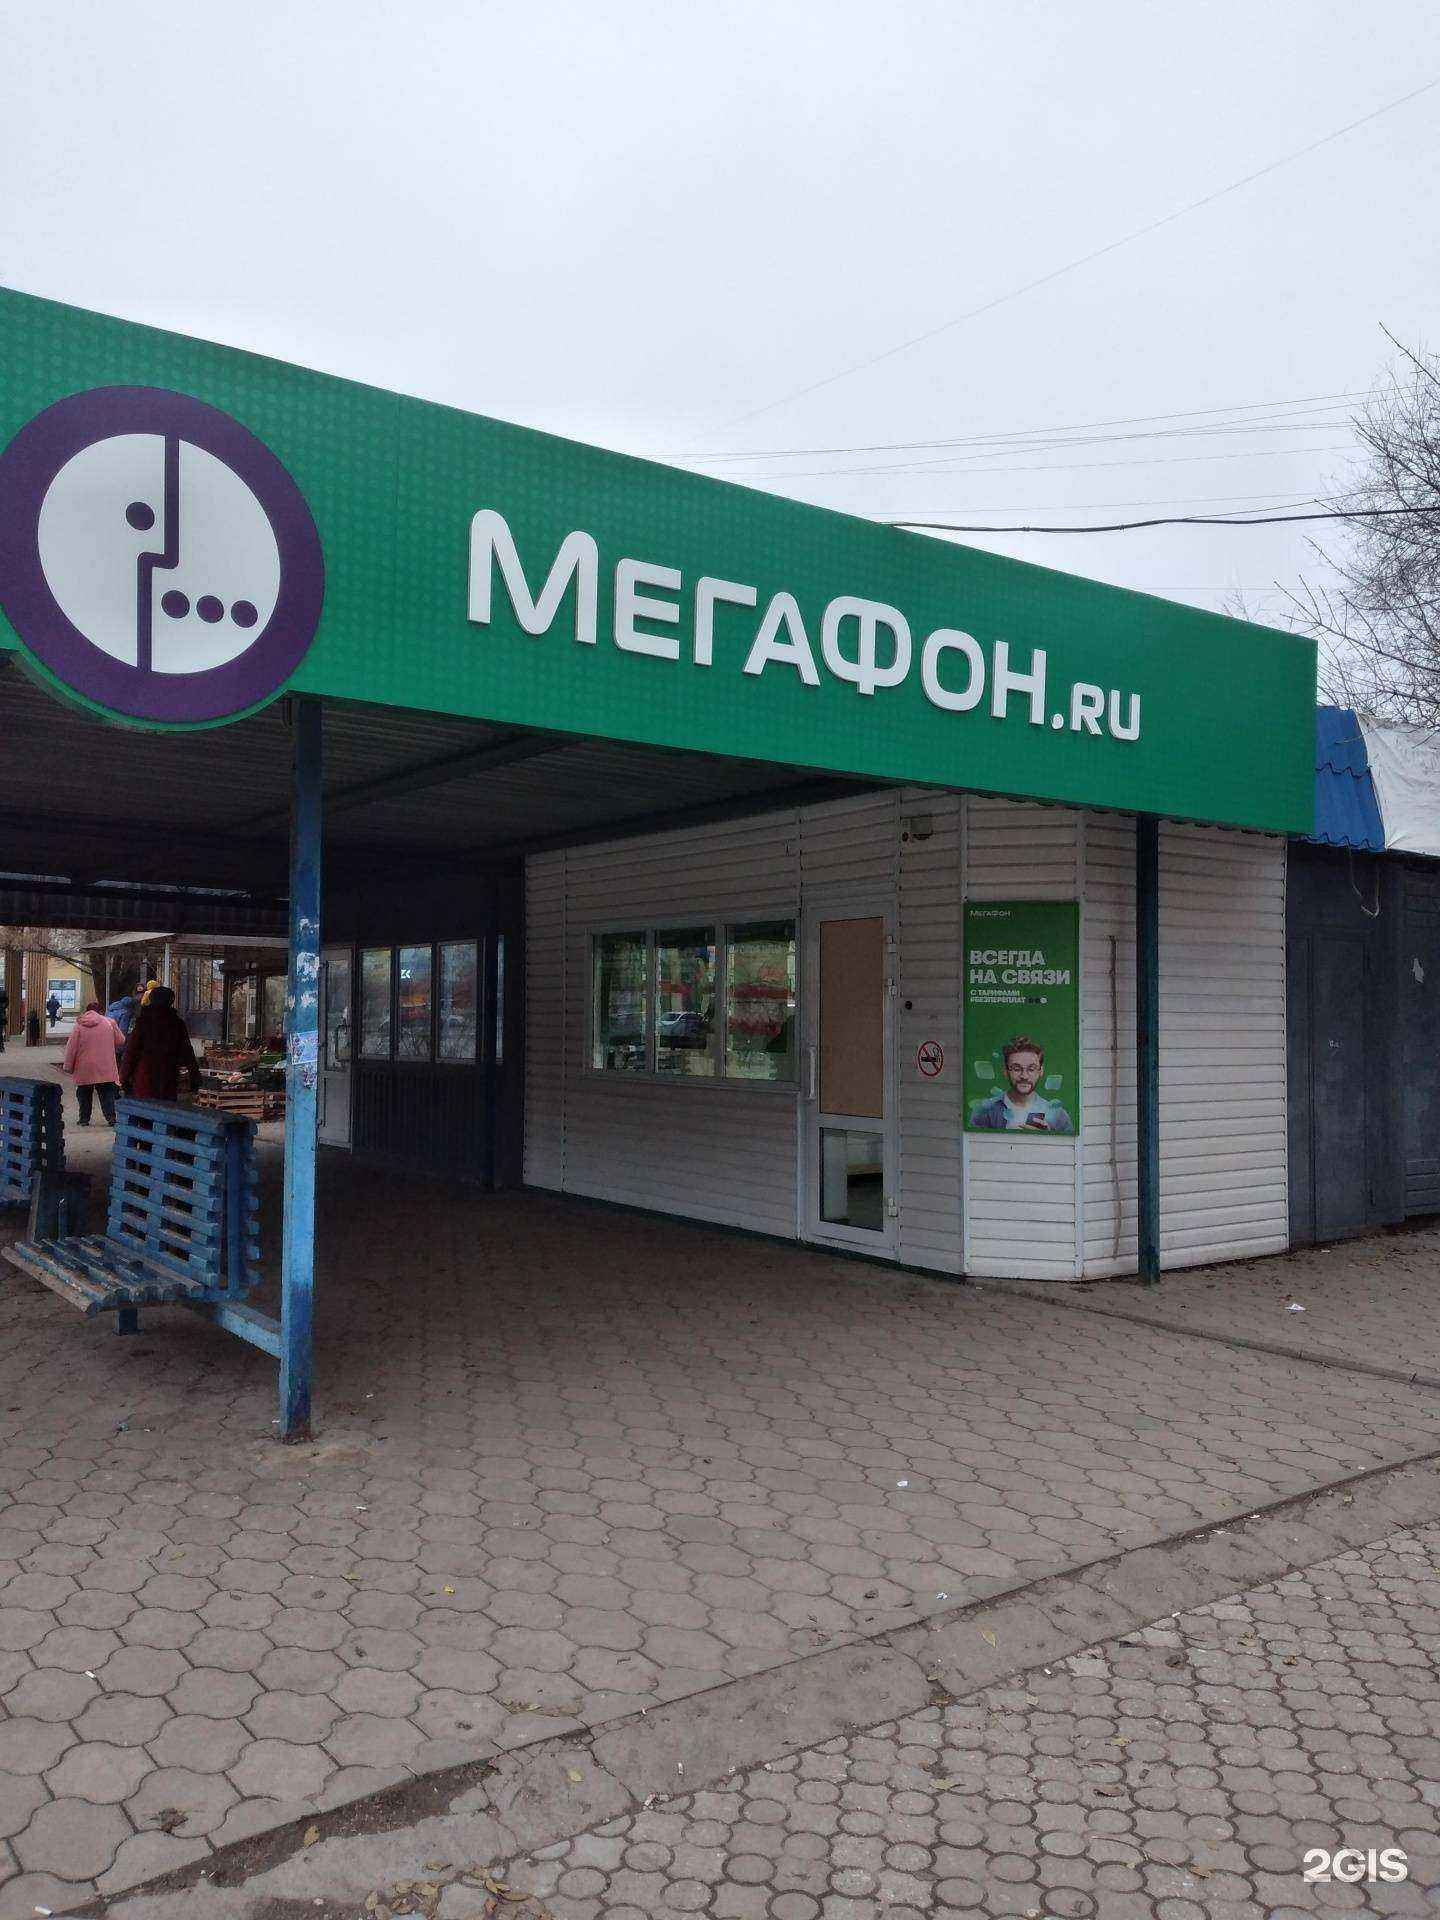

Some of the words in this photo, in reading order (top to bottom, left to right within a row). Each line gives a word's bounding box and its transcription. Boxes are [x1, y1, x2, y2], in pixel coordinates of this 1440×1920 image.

[970, 950, 1046, 967] ВСЕГДА
[970, 969, 997, 984] НА
[1002, 969, 1071, 985] СВЯЗИ
